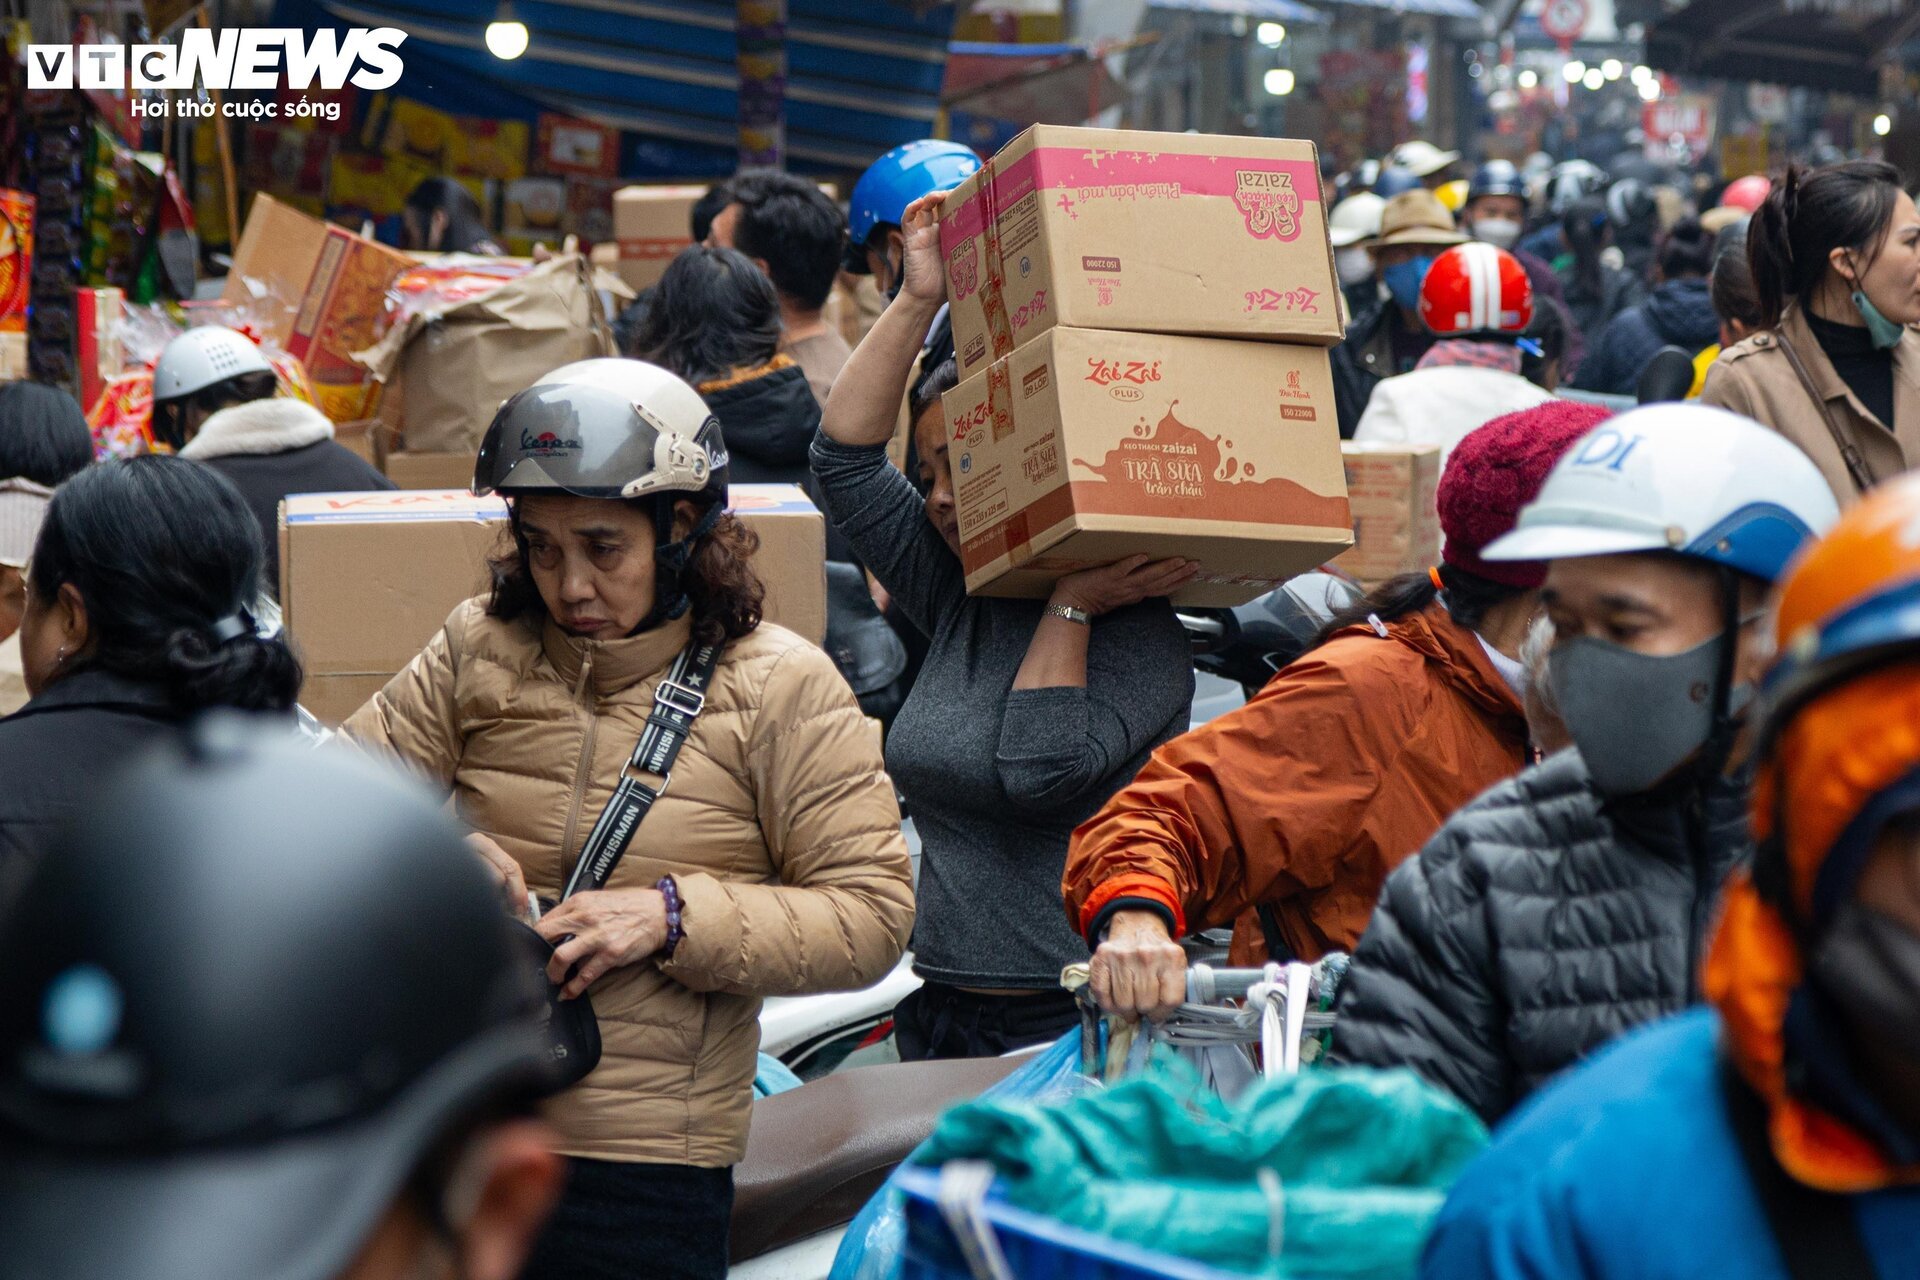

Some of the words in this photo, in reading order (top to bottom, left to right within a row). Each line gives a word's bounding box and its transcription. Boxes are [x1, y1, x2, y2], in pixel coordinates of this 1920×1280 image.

[1237, 172, 1291, 192] zaizai
[1106, 260, 1117, 269] ISO
[1114, 388, 1140, 399] PLUS
[1283, 408, 1294, 417] ISO
[968, 432, 983, 445] PLUS
[1161, 442, 1198, 455] zaizai
